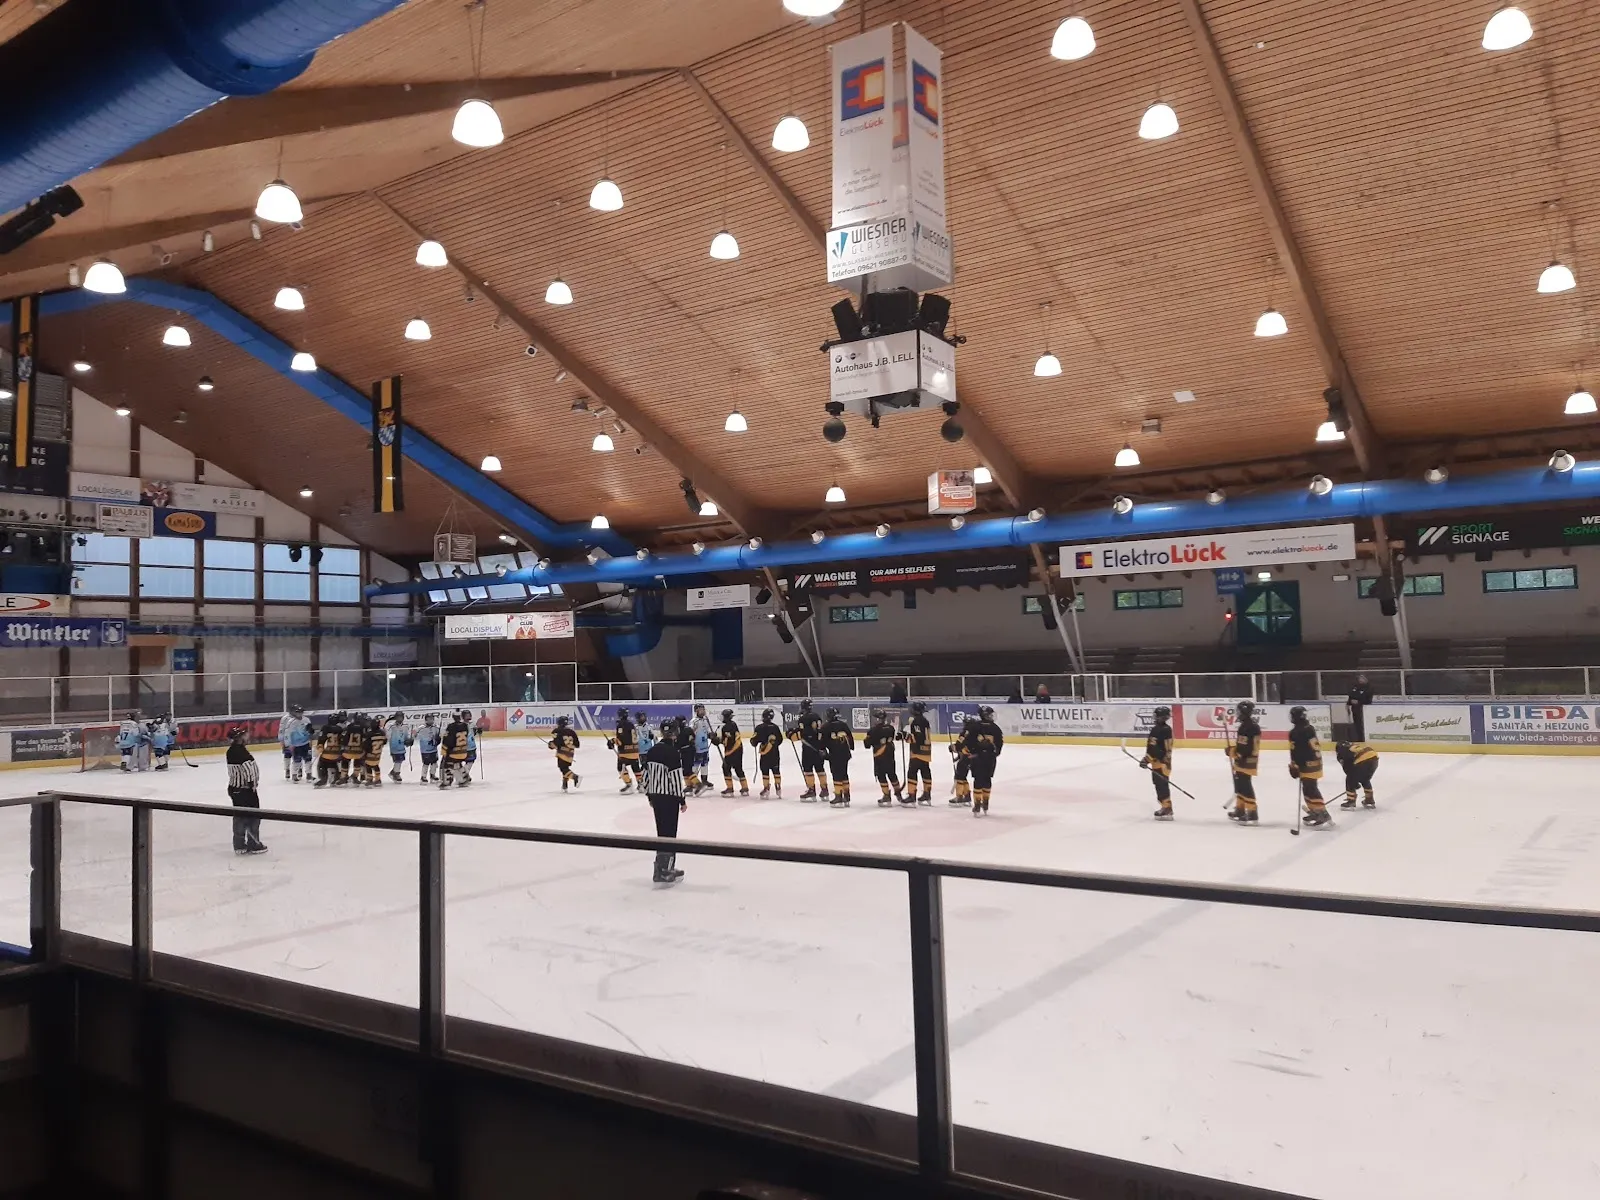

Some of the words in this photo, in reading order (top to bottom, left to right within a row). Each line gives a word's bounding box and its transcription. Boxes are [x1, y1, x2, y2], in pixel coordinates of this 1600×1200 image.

[851, 217, 907, 244] WIESNER
[851, 233, 907, 255] GLASBAU
[832, 267, 856, 278] Telefon
[857, 261, 878, 272] 09621
[835, 361, 873, 373] Autohaus
[874, 357, 891, 367] J.B.
[892, 352, 915, 363] LELL
[77, 485, 133, 497] LOCALDISPLAY
[212, 498, 257, 508] KAISER
[1452, 523, 1494, 535] SPORT
[1563, 526, 1600, 535] SIGNA
[1452, 531, 1510, 544] SIGNAGE
[1103, 541, 1227, 567] ElektroLück
[1246, 543, 1338, 556] www.elektrolueck.de
[905, 565, 936, 573] SELFLESS
[814, 571, 857, 582] WAGNER
[6, 623, 91, 641] Winkler
[450, 626, 503, 634] LOCALDISPLAY
[1020, 708, 1104, 720] WELTWEIT...
[1491, 705, 1590, 720] BIEDA
[525, 713, 574, 725] Domin's
[1491, 721, 1534, 730] SANITÄR
[1544, 722, 1590, 731] HEIZUNG
[1492, 733, 1598, 744] www.bieda-amberg.de
